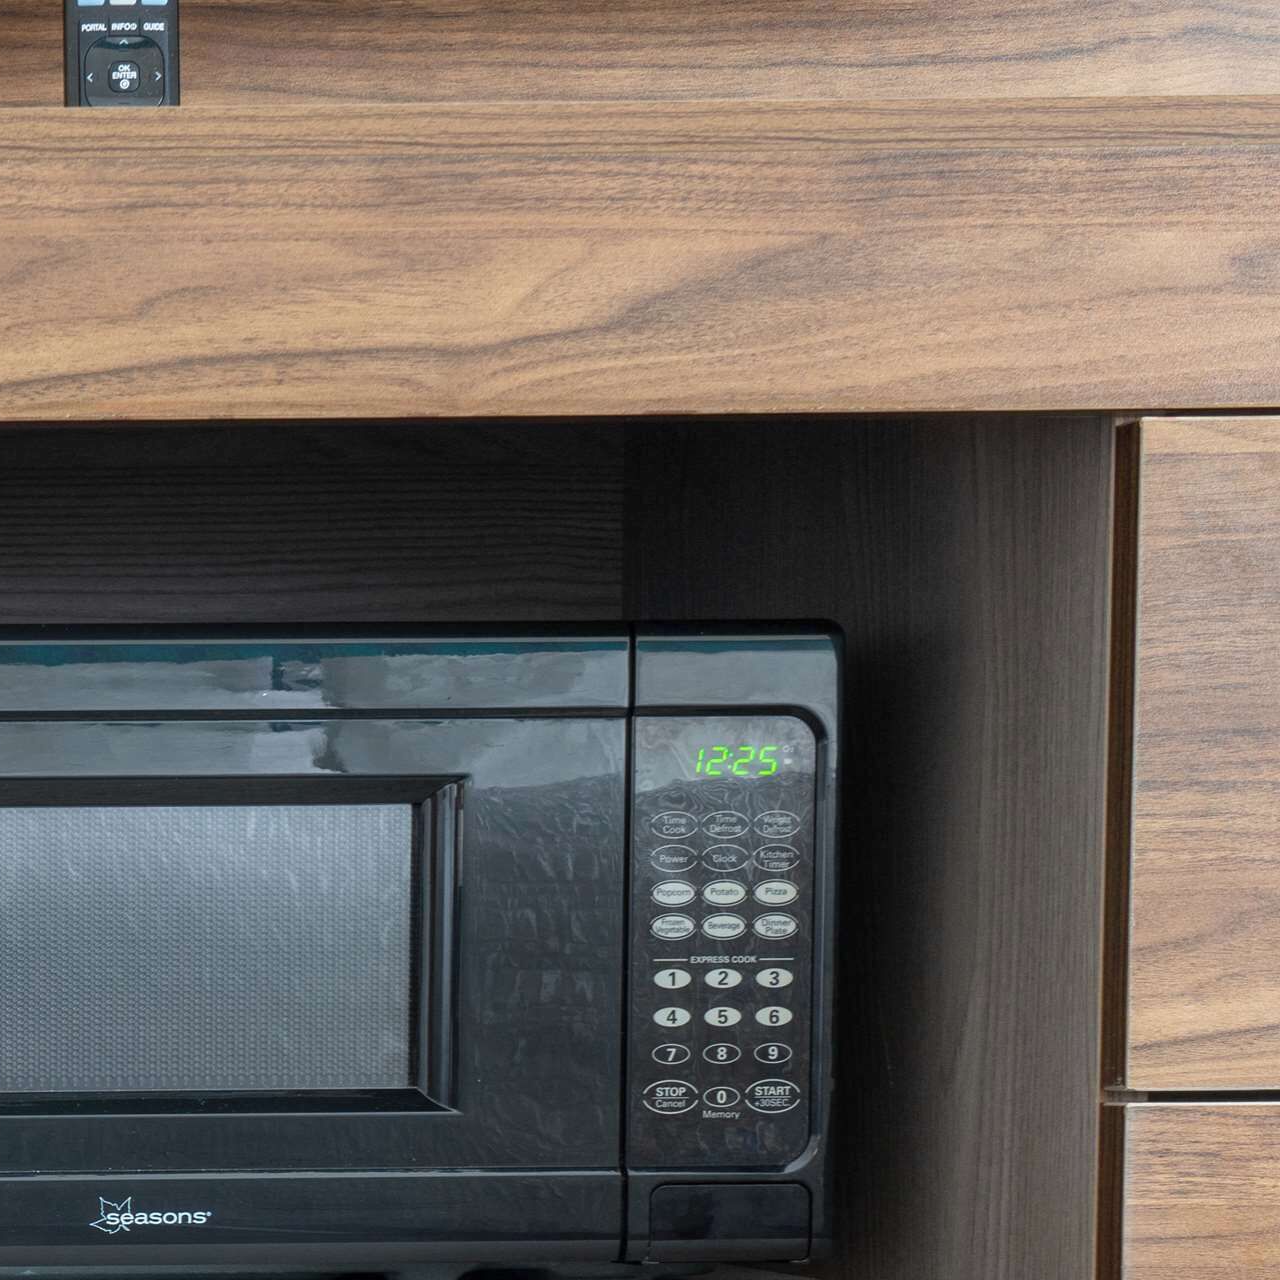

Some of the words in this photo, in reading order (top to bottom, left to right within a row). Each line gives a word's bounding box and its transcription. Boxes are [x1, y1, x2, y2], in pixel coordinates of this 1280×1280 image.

[81, 23, 107, 32] PORTAL
[143, 22, 165, 31] GUIDE
[118, 64, 131, 72] OK
[112, 71, 137, 80] ENTER
[696, 745, 778, 776] 12:25
[663, 816, 687, 824] Time
[715, 815, 737, 823] Time
[662, 825, 686, 834] Cook
[709, 824, 742, 833] Defrost
[659, 854, 688, 863] Power
[712, 854, 736, 863] Clock
[760, 850, 794, 859] Kitchen
[763, 859, 790, 868] Timer
[656, 887, 691, 897] Popcorn
[710, 887, 739, 896] Potato
[765, 887, 788, 895] Pizza
[661, 918, 685, 926] Frozen
[708, 921, 740, 931] Beverage
[761, 918, 790, 927] Dinner
[655, 926, 690, 935] Vegetable
[765, 926, 788, 935] Plate
[690, 955, 730, 964] EXPRESS
[732, 955, 758, 964] COOK
[668, 971, 676, 987] 1
[718, 971, 729, 986] 2
[769, 971, 780, 986] 3
[666, 1009, 677, 1024] 4
[718, 1009, 728, 1024] 5
[769, 1009, 780, 1024] 6
[666, 1048, 677, 1061] 7
[716, 1046, 727, 1060] 8
[768, 1046, 779, 1060] 9
[655, 1087, 687, 1097] STOP
[754, 1086, 791, 1096] START
[716, 1090, 727, 1104] 0
[655, 1099, 686, 1108] Cancel
[702, 1110, 740, 1120] Memory
